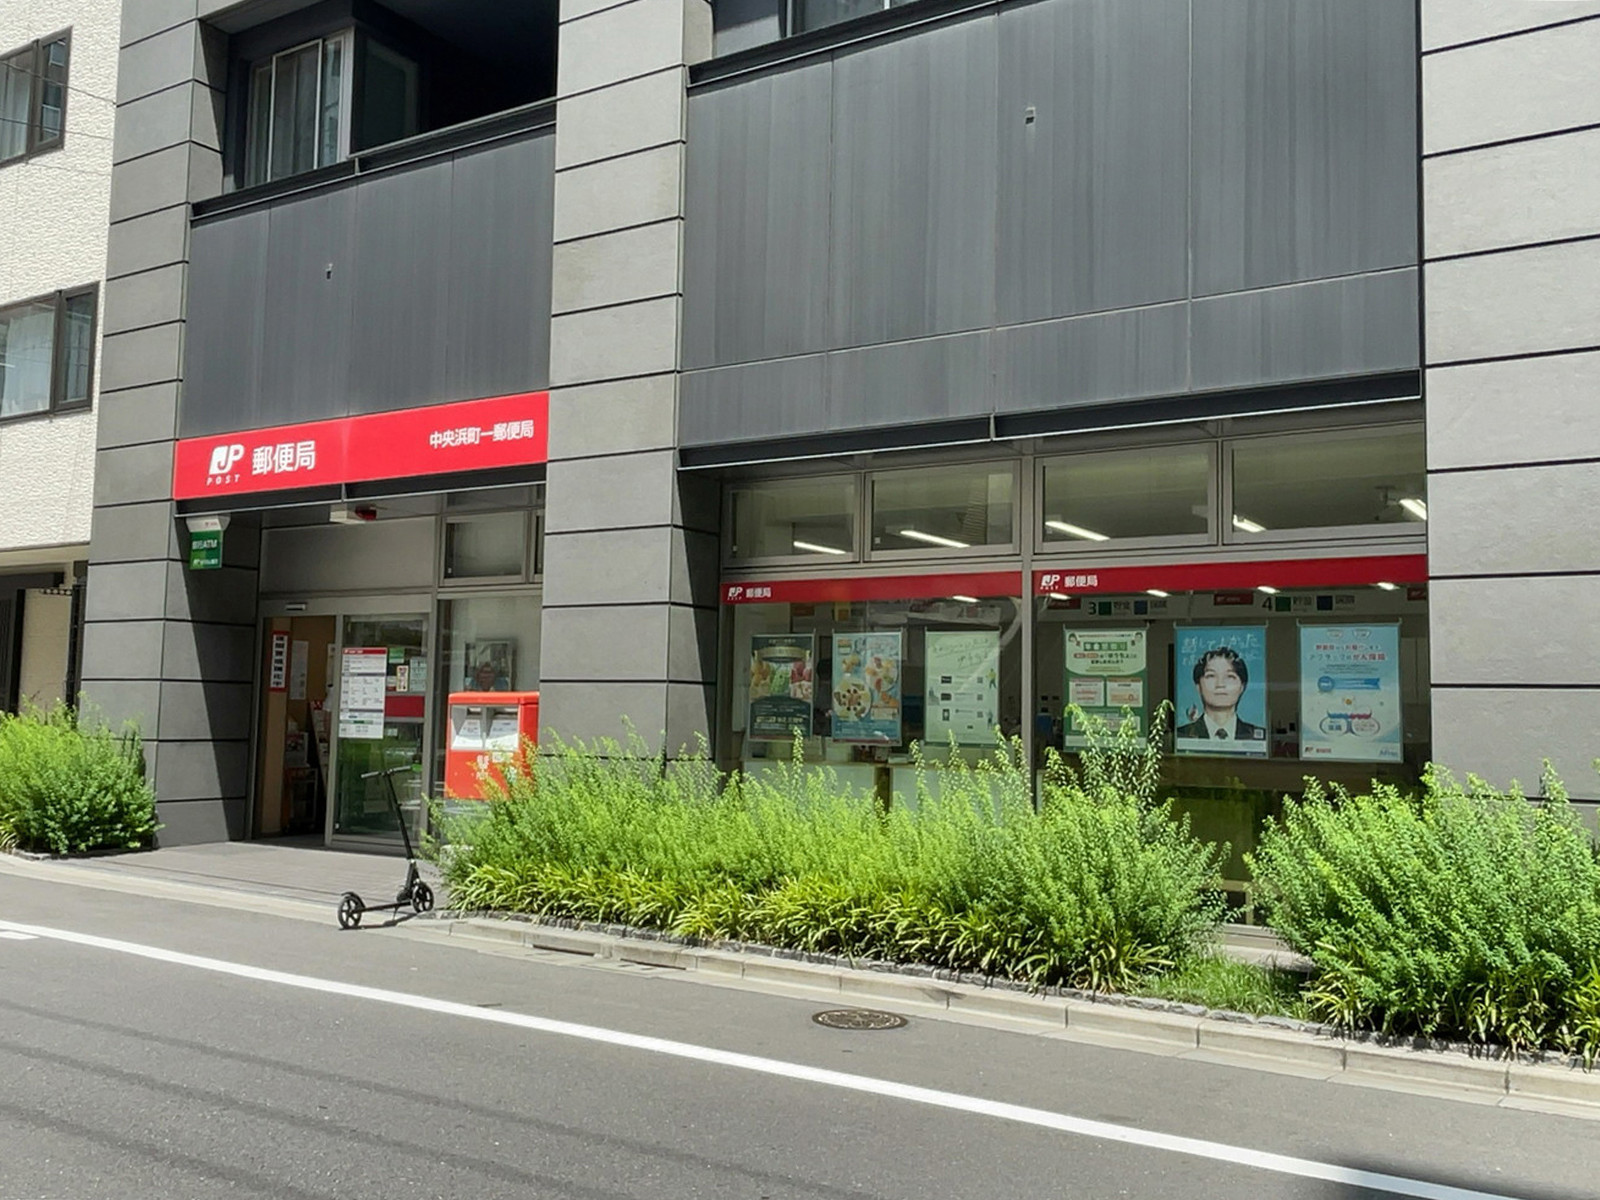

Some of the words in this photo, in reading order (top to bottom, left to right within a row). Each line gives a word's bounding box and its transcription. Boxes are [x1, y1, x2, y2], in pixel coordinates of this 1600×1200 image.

[429, 419, 534, 449] 中央浜町一郵便局
[208, 443, 245, 475] JP
[251, 440, 316, 475] 郵便局
[206, 474, 240, 486] POST
[1041, 574, 1061, 587] JP
[1064, 574, 1098, 588] 郵便局
[1088, 601, 1097, 615] 3
[1262, 597, 1273, 611] 4
